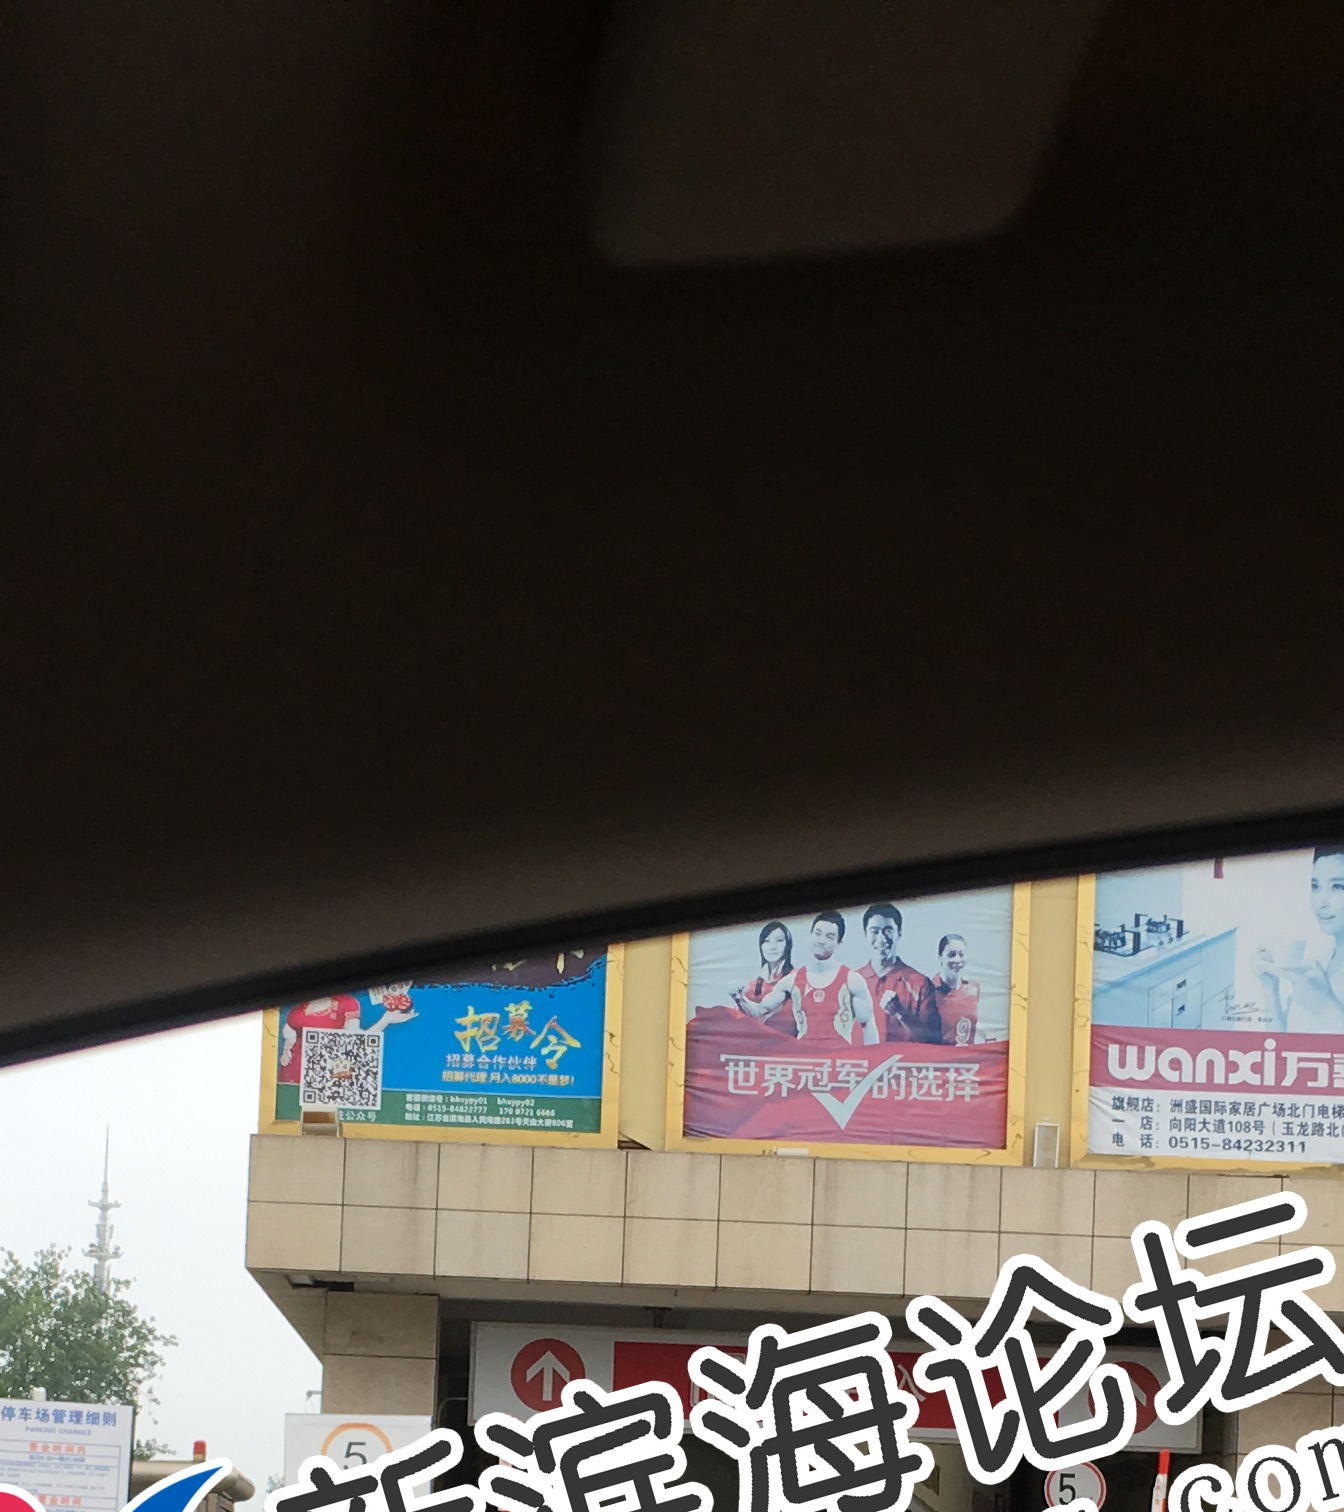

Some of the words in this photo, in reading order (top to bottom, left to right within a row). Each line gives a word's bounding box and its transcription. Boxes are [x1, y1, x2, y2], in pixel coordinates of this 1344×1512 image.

[454, 1000, 582, 1070] 招募令
[445, 1052, 538, 1071] 招募合作伙伴
[720, 1054, 982, 1103] 世界冠军的选择
[0, 1405, 117, 1428] 停车场管理细则
[344, 1441, 368, 1470] 5
[1058, 1473, 1077, 1506] 5
